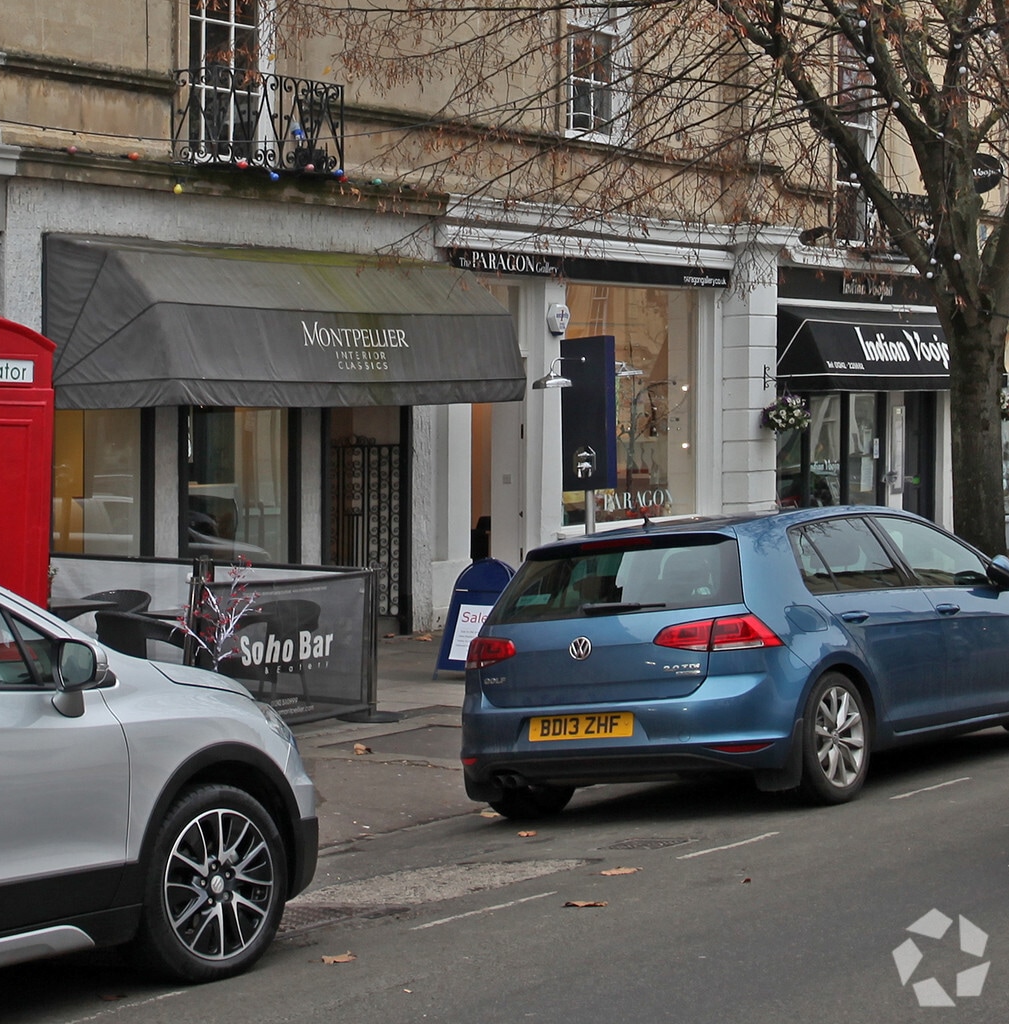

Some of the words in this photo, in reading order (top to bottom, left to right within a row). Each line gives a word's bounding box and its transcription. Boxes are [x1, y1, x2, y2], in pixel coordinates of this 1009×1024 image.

[459, 256, 472, 267] The
[472, 251, 535, 273] PARAGON
[301, 320, 410, 352] MONTPELLIER
[853, 326, 910, 362] Indian
[335, 351, 387, 361] INTERIOR
[337, 361, 389, 371] CLASSICS
[603, 489, 673, 512] PARAGON
[461, 611, 489, 624] Sale
[240, 634, 294, 666] Soho
[299, 630, 334, 660] Bar
[539, 717, 580, 737] BD13
[584, 715, 622, 735] ZHF
